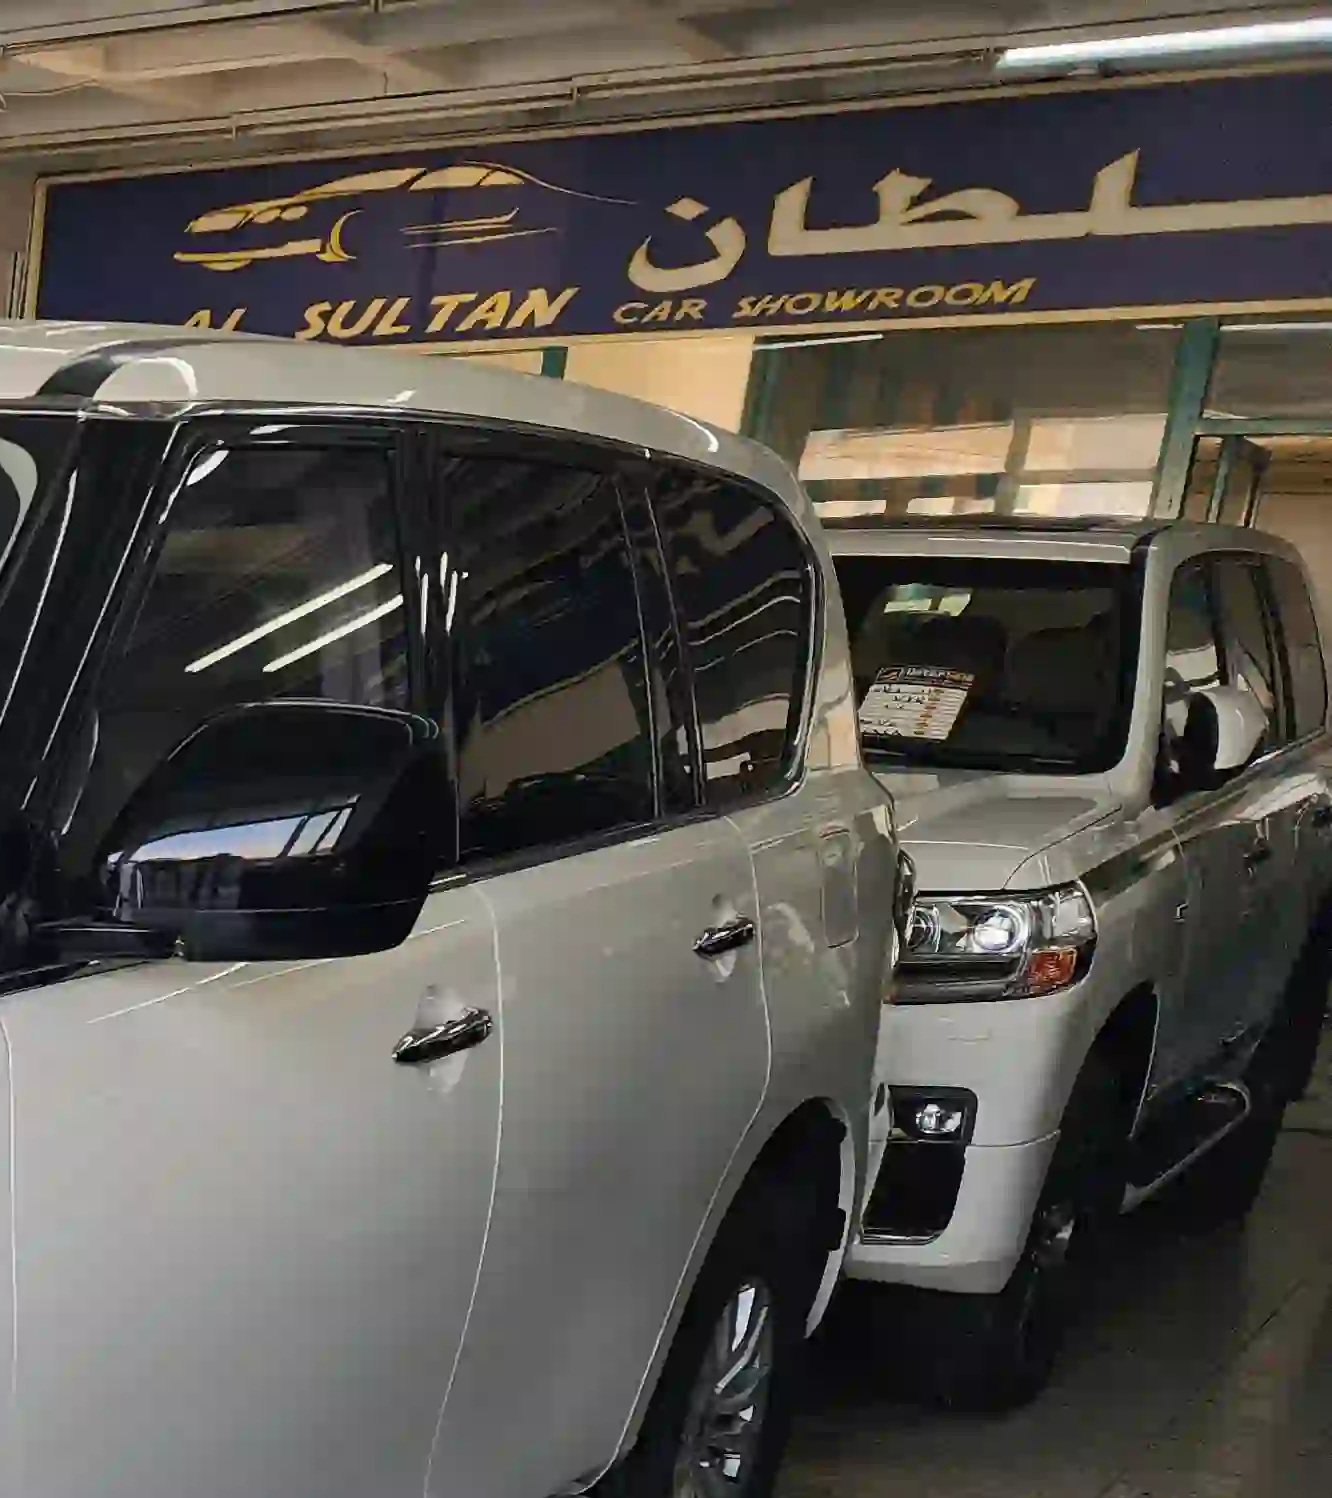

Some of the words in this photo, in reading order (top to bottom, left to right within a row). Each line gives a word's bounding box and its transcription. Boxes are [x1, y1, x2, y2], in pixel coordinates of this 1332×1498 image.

[293, 287, 579, 342] SULTAN
[611, 298, 707, 325] CAR
[732, 277, 1037, 319] SHOWROOM
